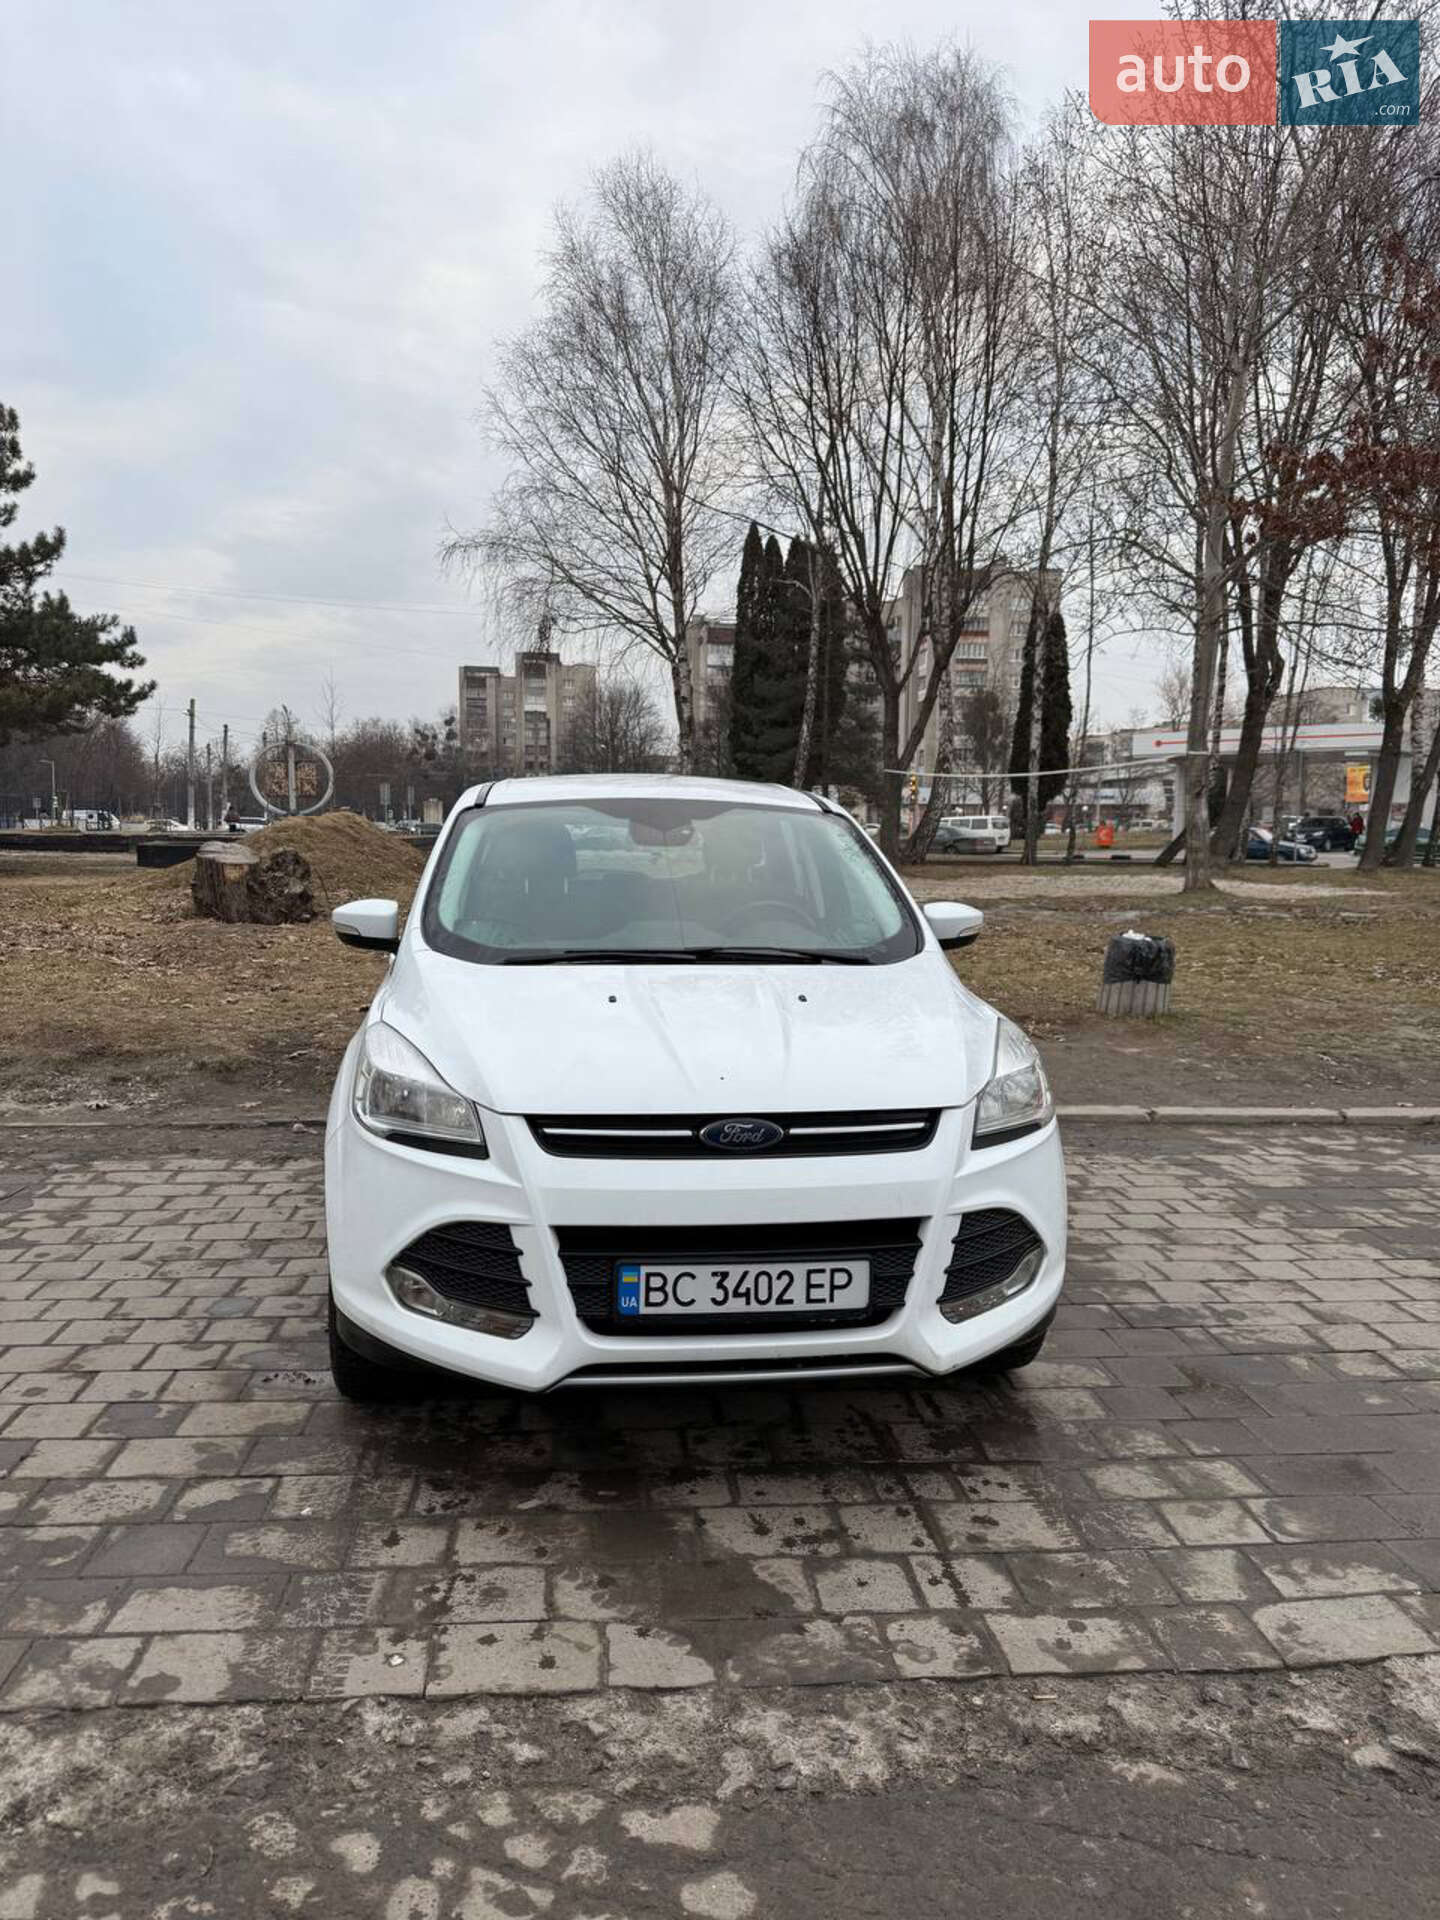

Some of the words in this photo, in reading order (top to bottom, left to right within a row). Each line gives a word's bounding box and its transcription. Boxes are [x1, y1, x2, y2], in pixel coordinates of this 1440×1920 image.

[720, 1123, 765, 1143] Ford
[644, 1272, 697, 1307] BC
[710, 1270, 795, 1306] 3402
[805, 1268, 853, 1304] EP
[621, 1296, 638, 1308] UA
